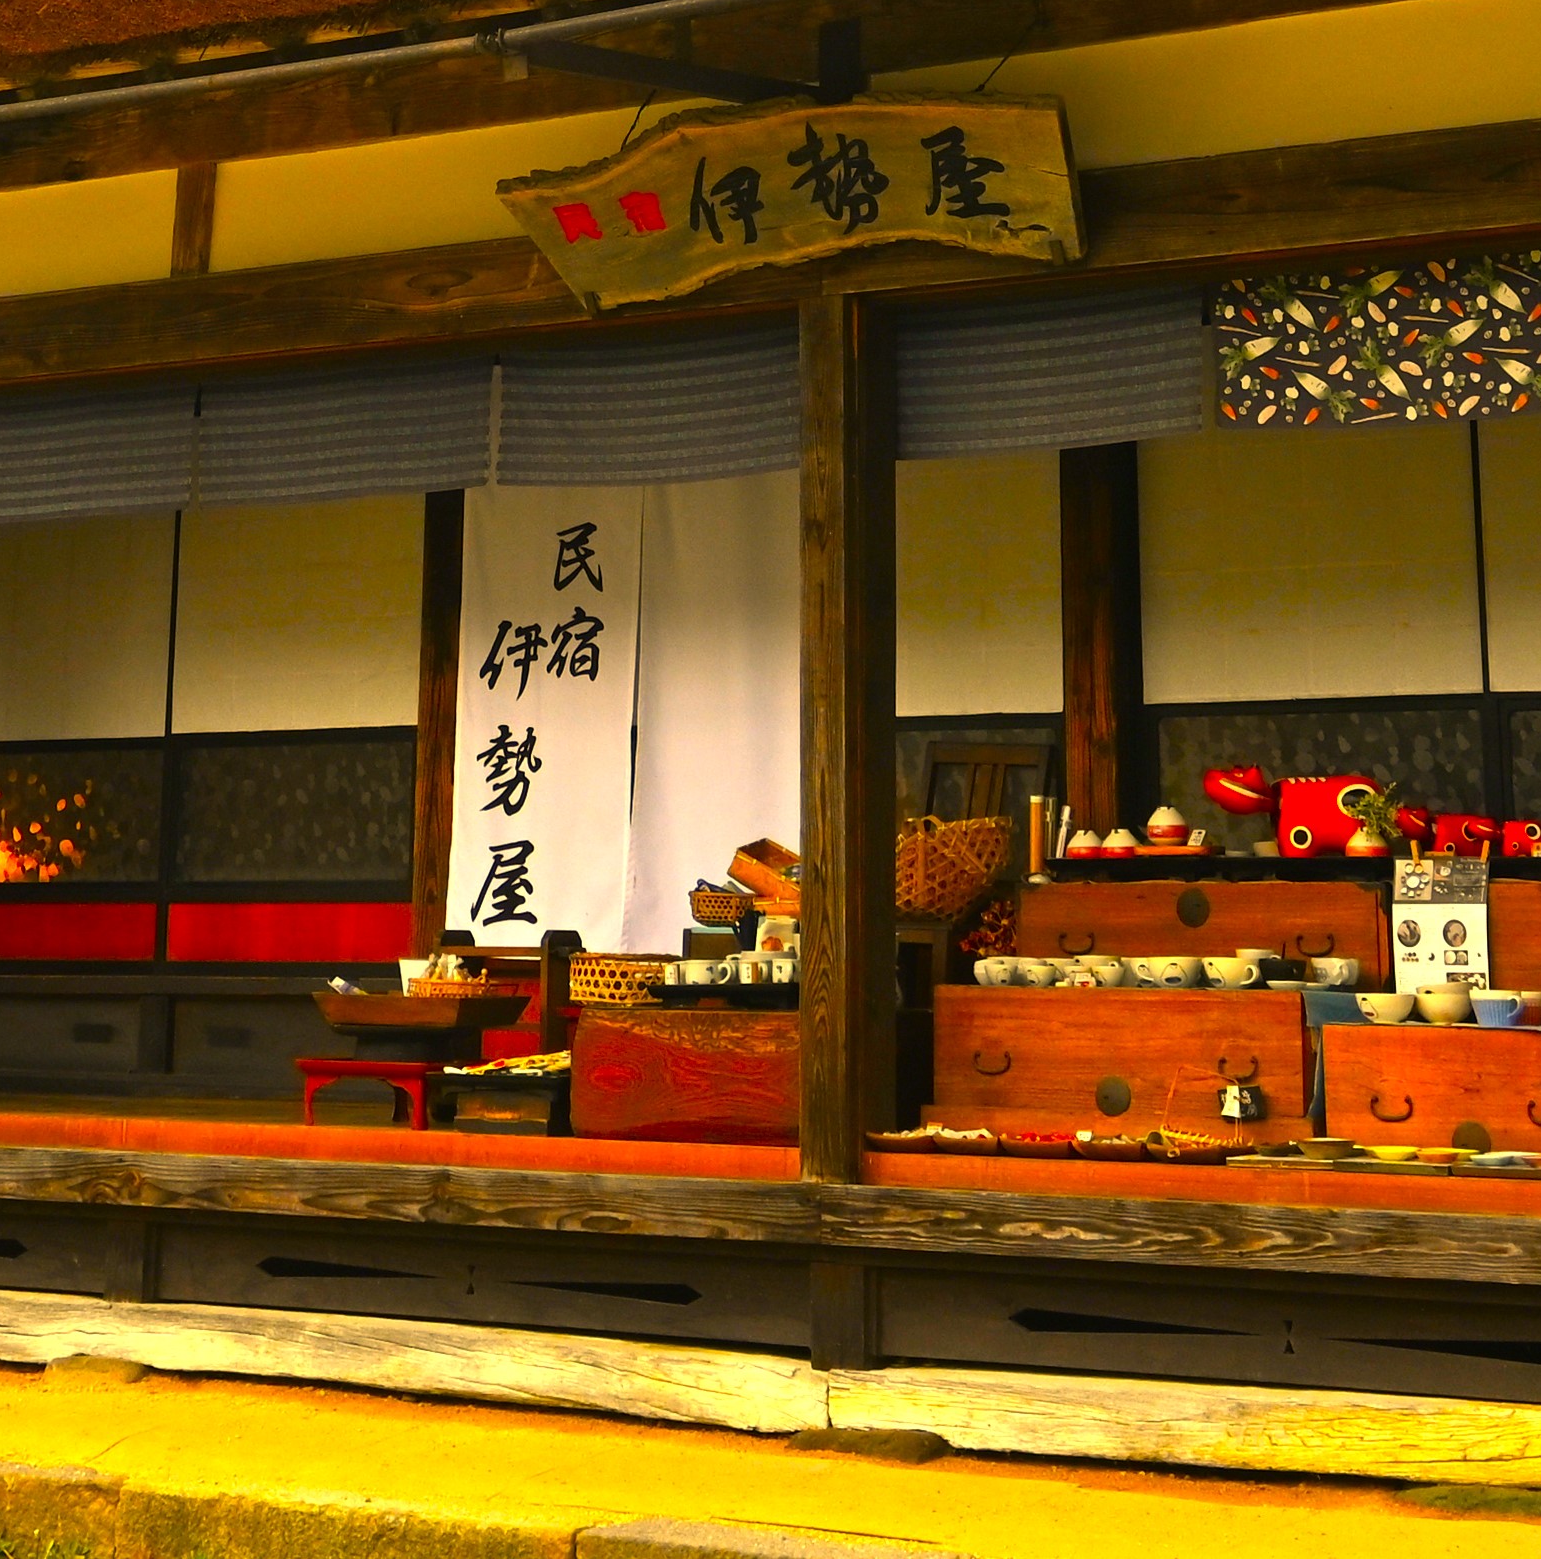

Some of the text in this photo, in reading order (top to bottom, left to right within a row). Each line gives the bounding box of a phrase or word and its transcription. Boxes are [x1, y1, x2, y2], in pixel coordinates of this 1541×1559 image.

[689, 121, 1011, 244] 伊勢屋
[546, 522, 605, 681] 民宿
[471, 620, 550, 925] 伊勢屋
